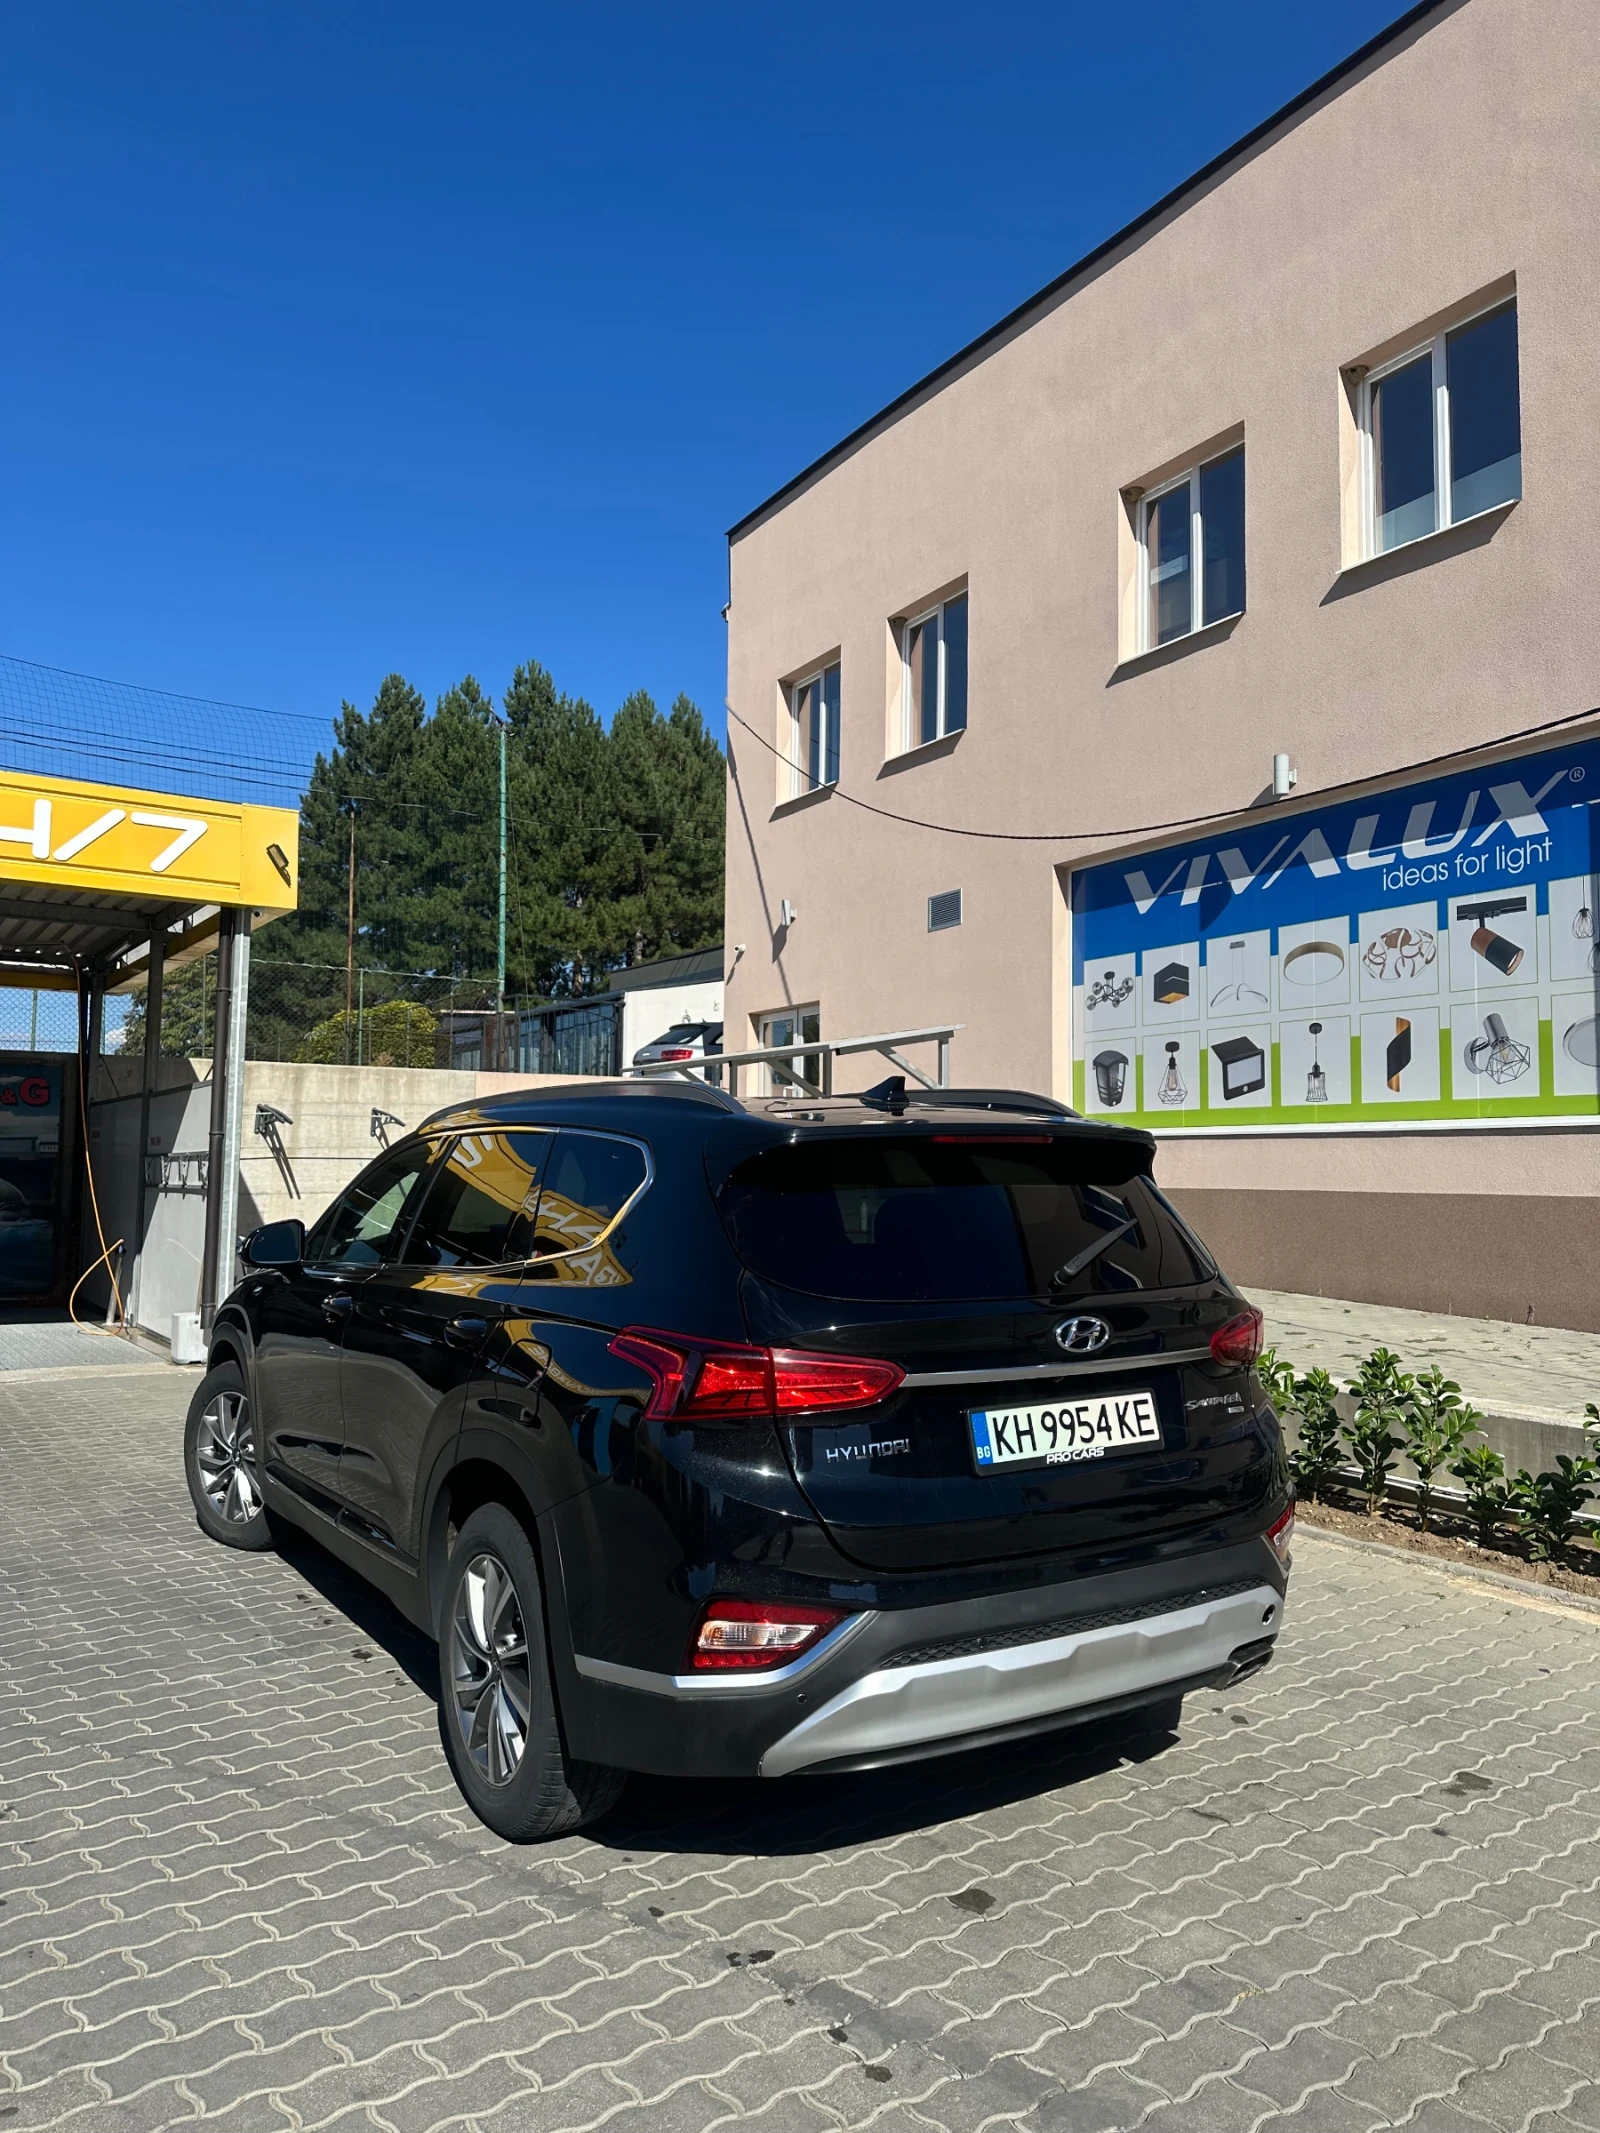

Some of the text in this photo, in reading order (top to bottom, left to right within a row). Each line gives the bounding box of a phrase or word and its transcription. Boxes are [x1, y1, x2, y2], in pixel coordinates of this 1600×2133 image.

[1123, 769, 1568, 915] VIVALUX
[1382, 836, 1553, 891] ideas for light
[1040, 1404, 1113, 1449] 9954
[825, 1438, 910, 1463] HYUNDAI
[976, 1445, 991, 1459] BG
